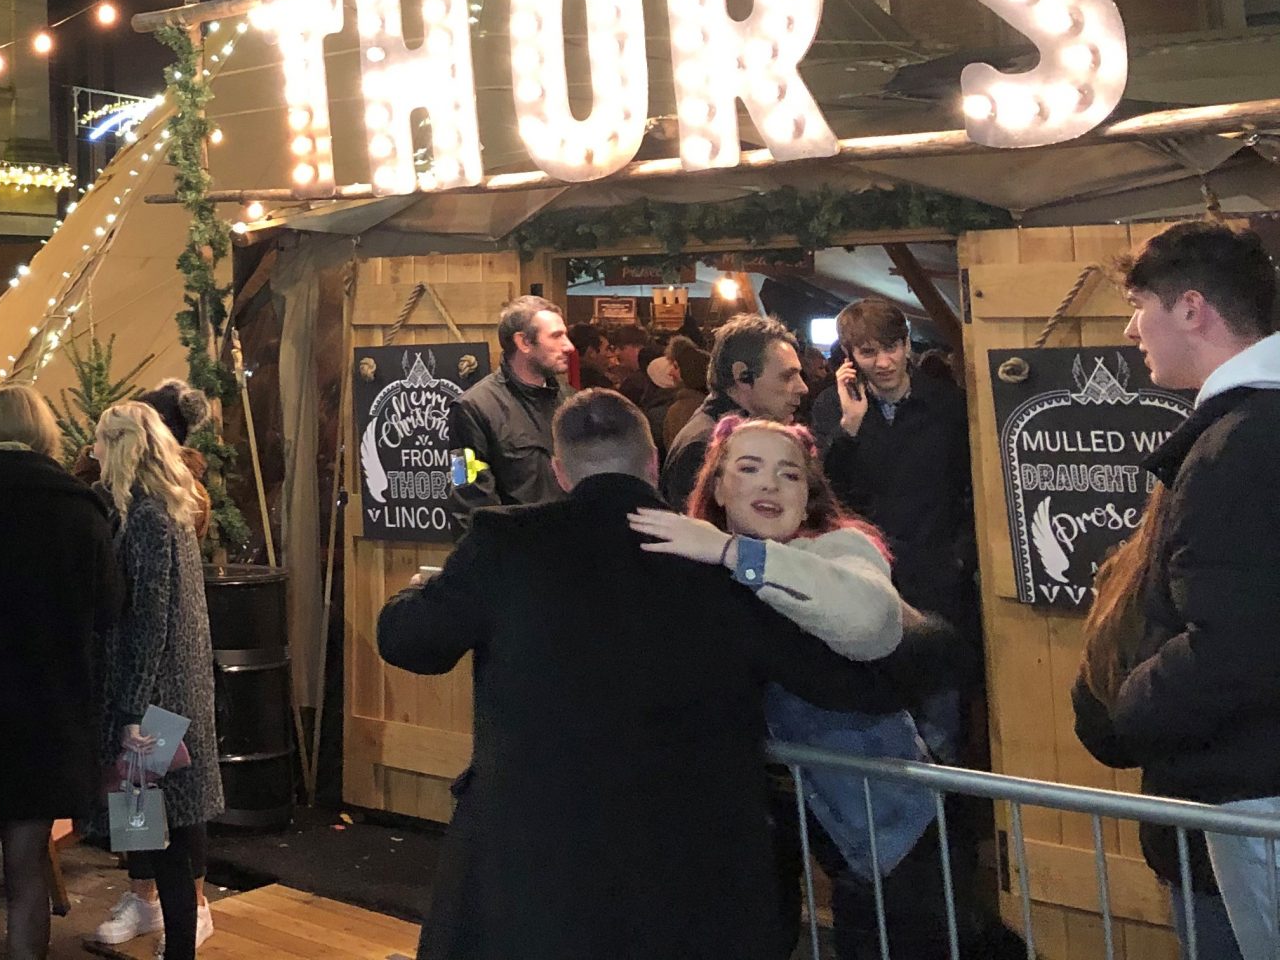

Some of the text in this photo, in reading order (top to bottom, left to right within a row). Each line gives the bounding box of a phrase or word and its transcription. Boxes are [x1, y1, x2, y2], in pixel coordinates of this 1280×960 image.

[1022, 431, 1125, 452] MULLED
[401, 448, 449, 467] FROM
[1022, 464, 1139, 493] DRAUGHT
